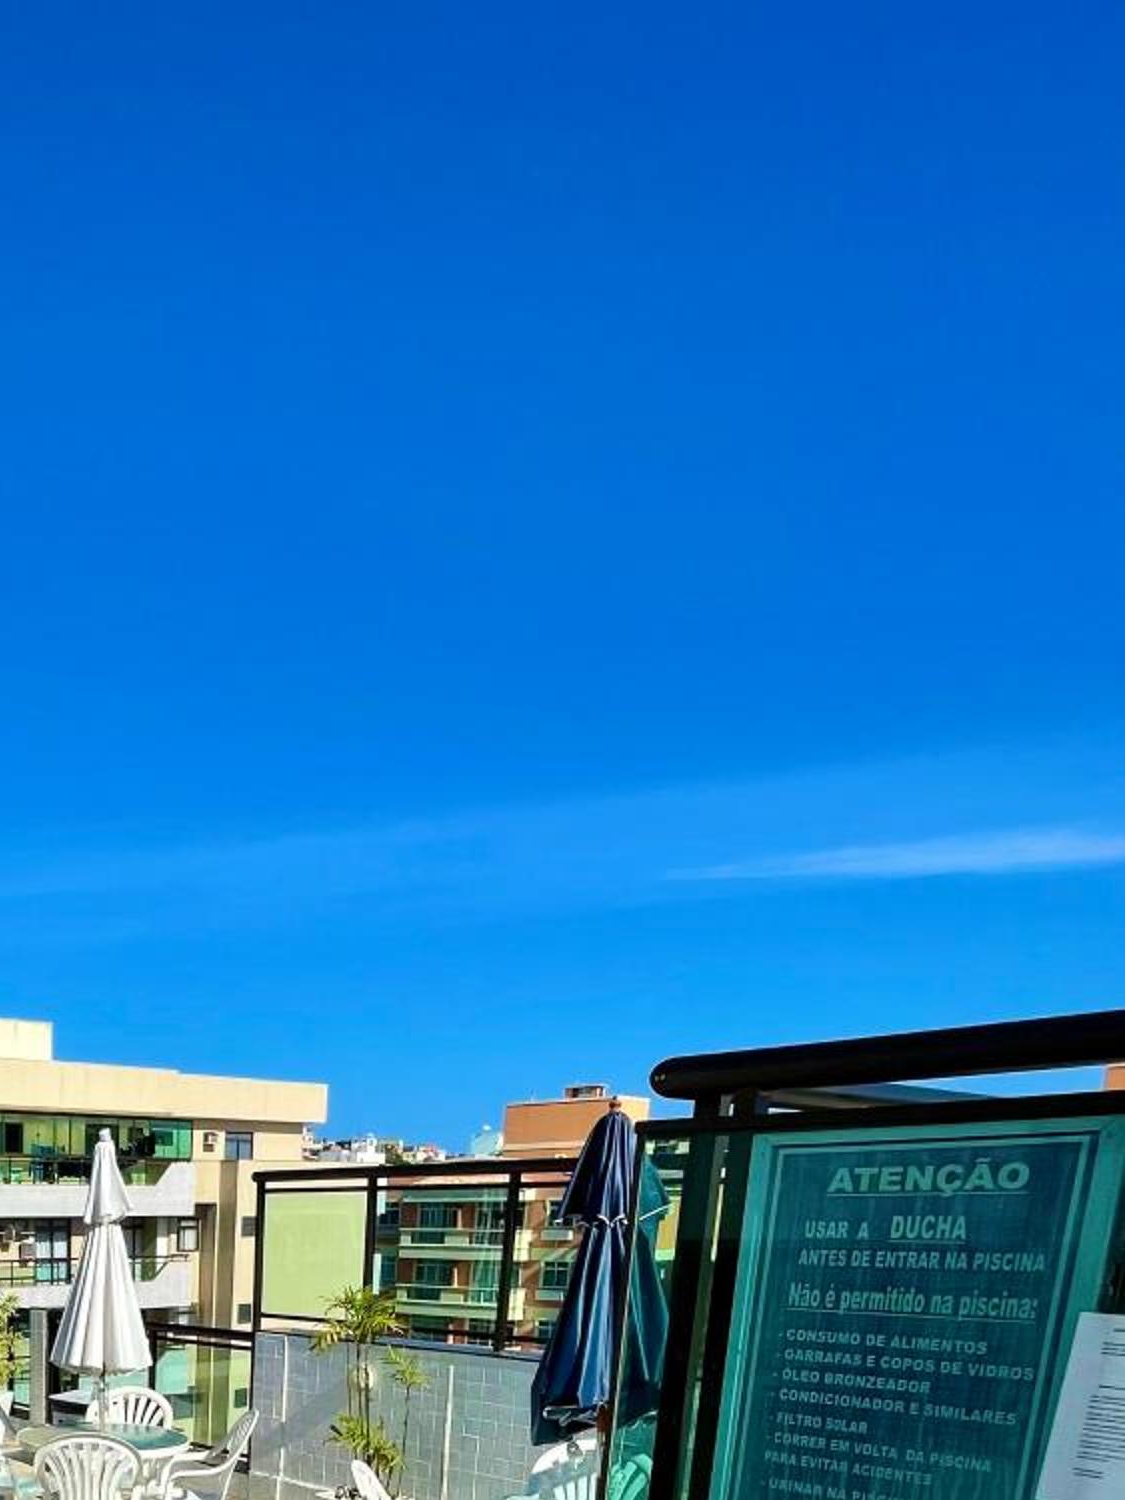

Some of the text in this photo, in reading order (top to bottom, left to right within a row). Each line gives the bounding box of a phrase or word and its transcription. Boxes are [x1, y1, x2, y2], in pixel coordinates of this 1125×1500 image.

[827, 1157, 1030, 1197] ATENÇÃO
[804, 1215, 967, 1240] USAR A DUCHA
[798, 1248, 1045, 1272] ANTES DE ENTRAR NA PISCINA
[787, 1281, 1038, 1320] Não é permitido na piscina:
[786, 1328, 988, 1355] CONSUMO DE ALIMENTOS
[784, 1348, 1035, 1381] GARRAFAS E COPOS DE VIDROS
[825, 1373, 931, 1393] BRONZEADOR
[779, 1387, 1017, 1425] CONDICIONADOR E SIMILARES
[776, 1411, 868, 1434] FILTRO SOLAR
[774, 1431, 992, 1472] CORRER EM VOLTA DA PISCINA
[764, 1450, 932, 1485] PARA EVITAR ACIDENTES
[827, 1486, 846, 1500] NA
